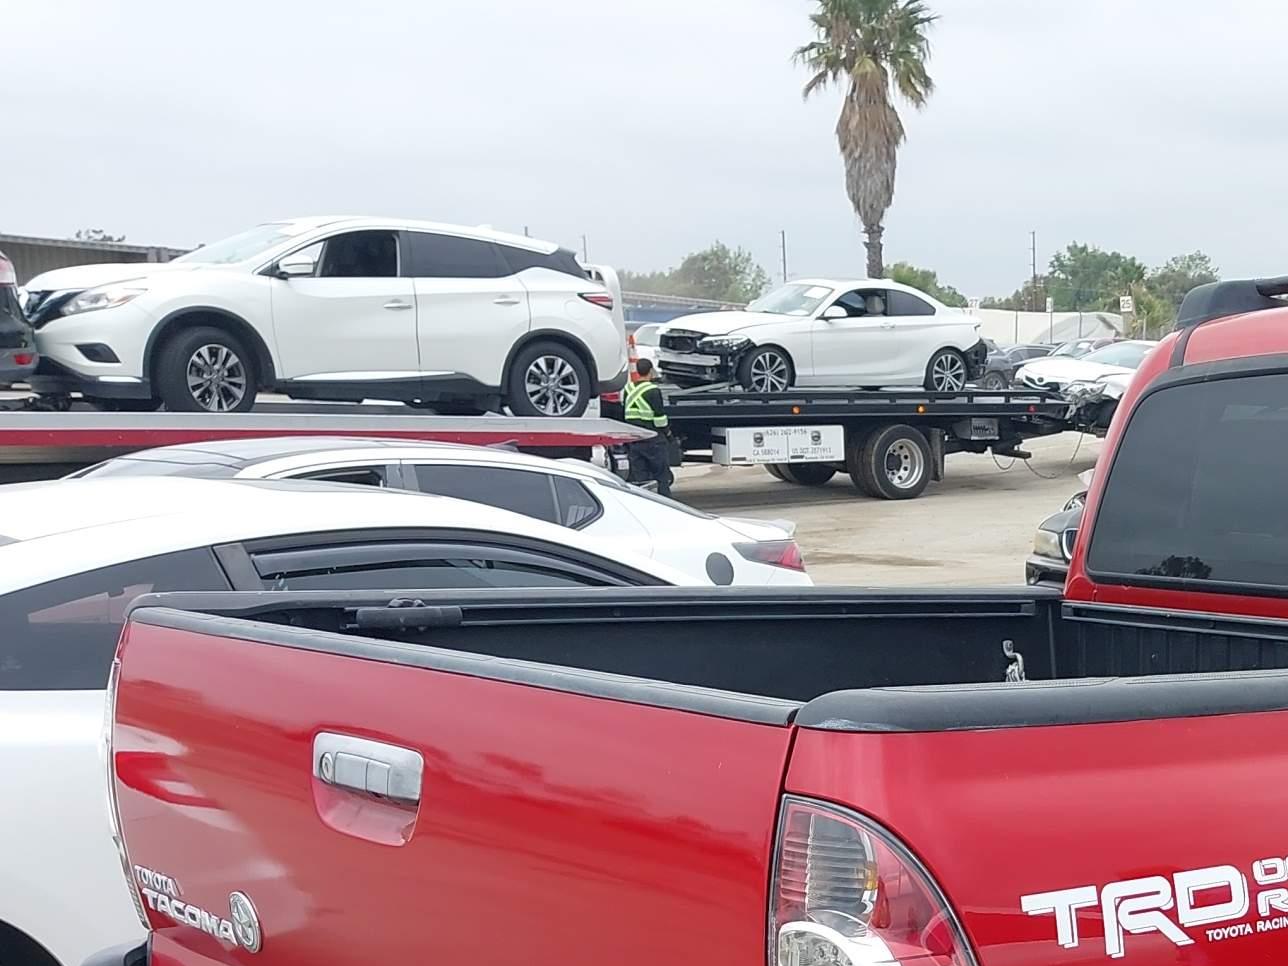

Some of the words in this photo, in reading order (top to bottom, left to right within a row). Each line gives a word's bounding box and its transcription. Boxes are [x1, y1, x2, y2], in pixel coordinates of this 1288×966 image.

[134, 864, 178, 897] TOYOTA
[142, 887, 239, 947] TACOMA
[1021, 864, 1249, 958] TRD
[1205, 923, 1253, 942] TOYOTA
